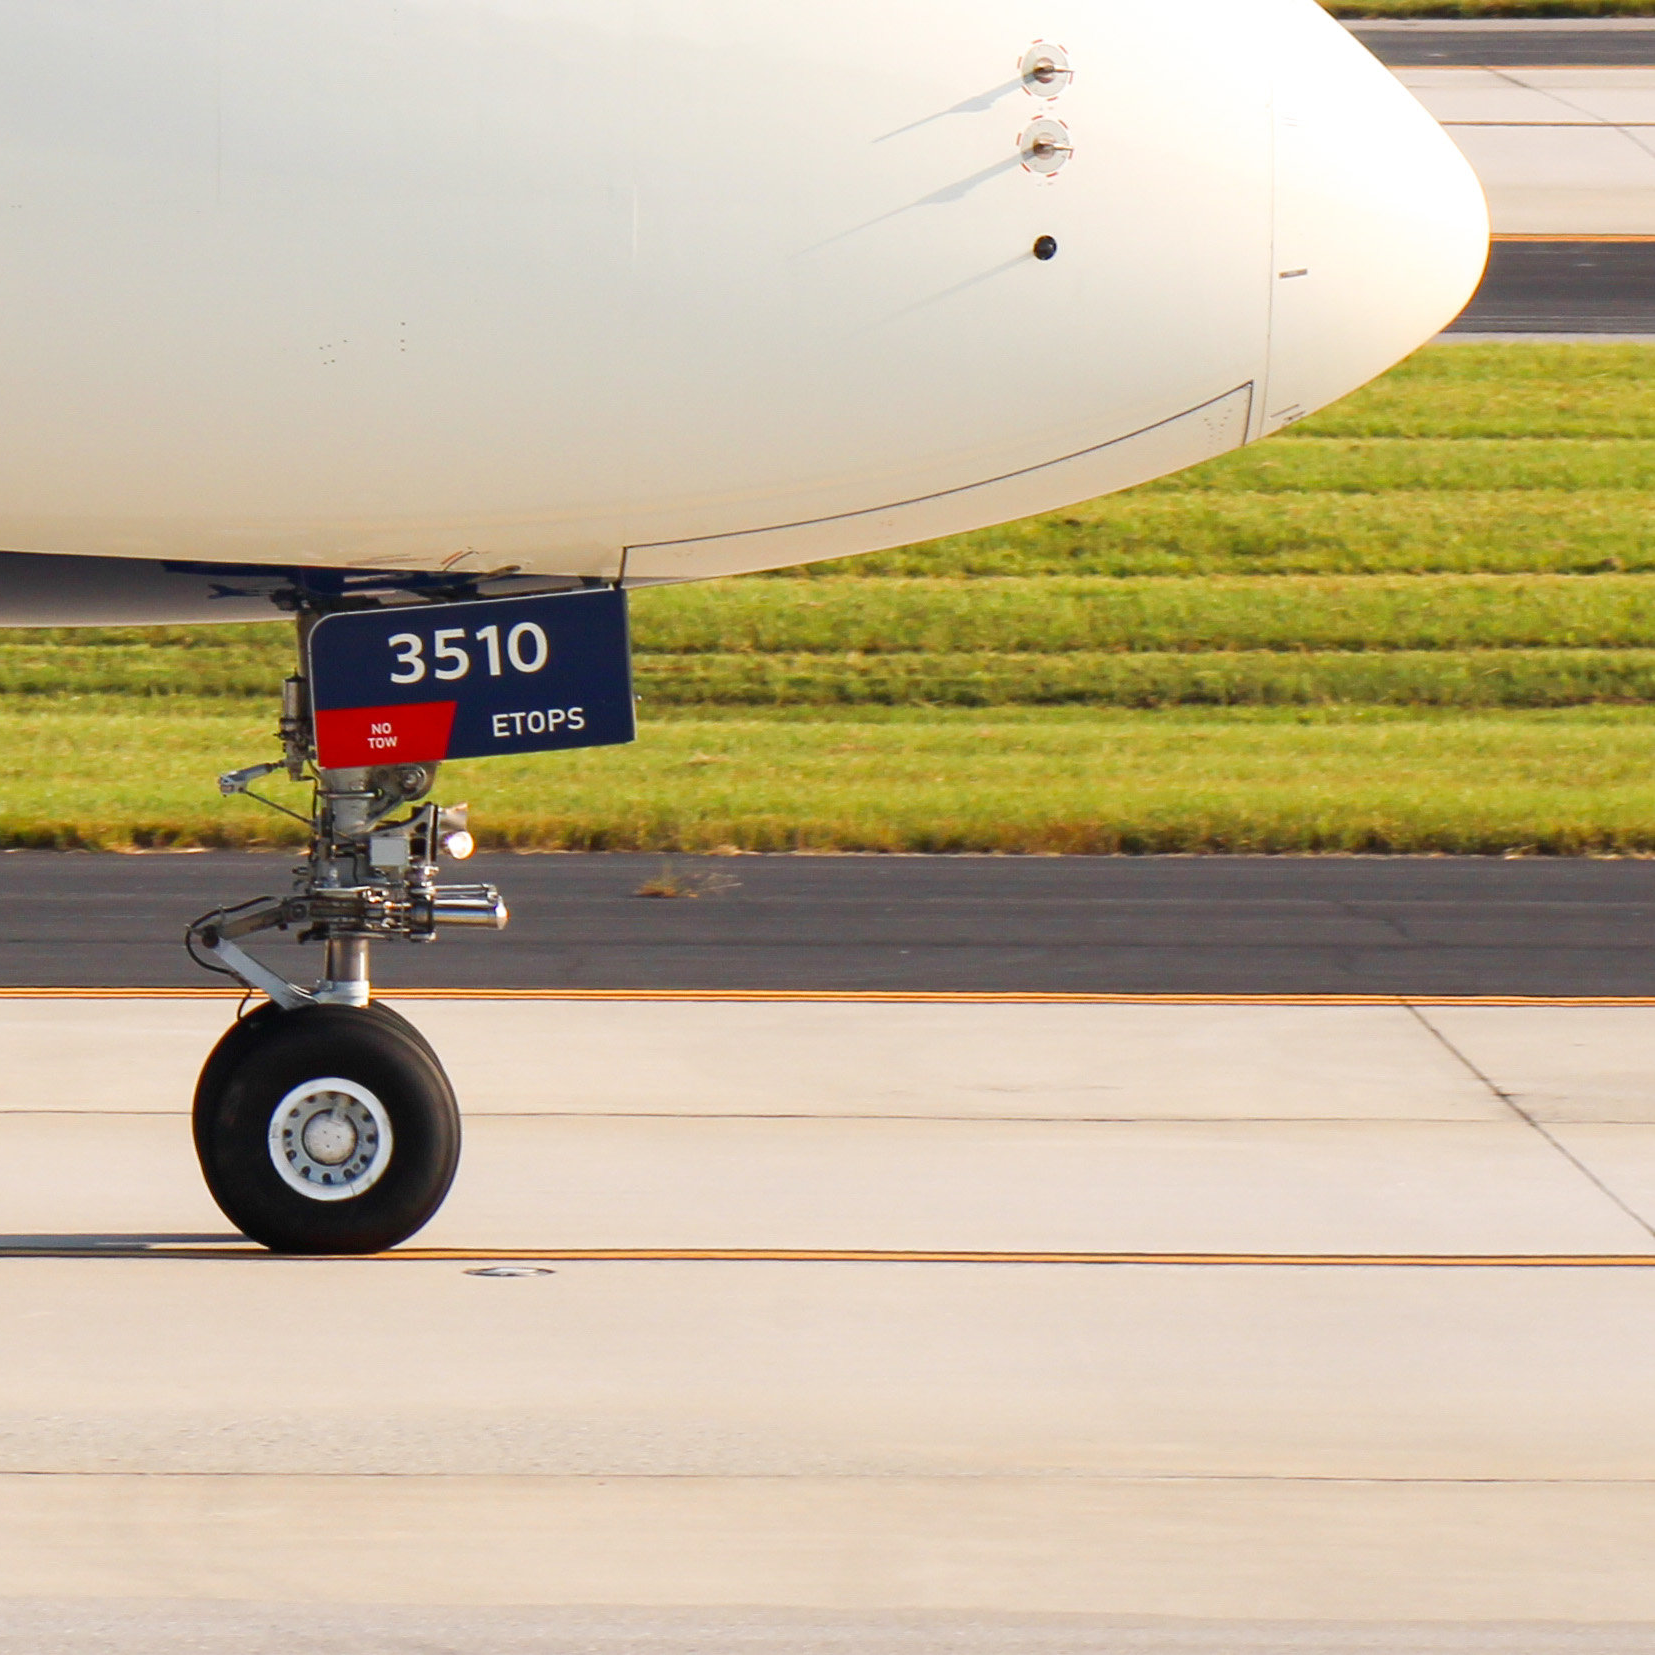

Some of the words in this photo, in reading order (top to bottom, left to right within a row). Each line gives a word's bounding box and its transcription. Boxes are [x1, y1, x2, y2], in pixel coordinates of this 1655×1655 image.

[388, 622, 548, 684] 3510
[371, 723, 392, 735] NO
[492, 707, 585, 738] ETOPS
[367, 736, 398, 749] TOW
